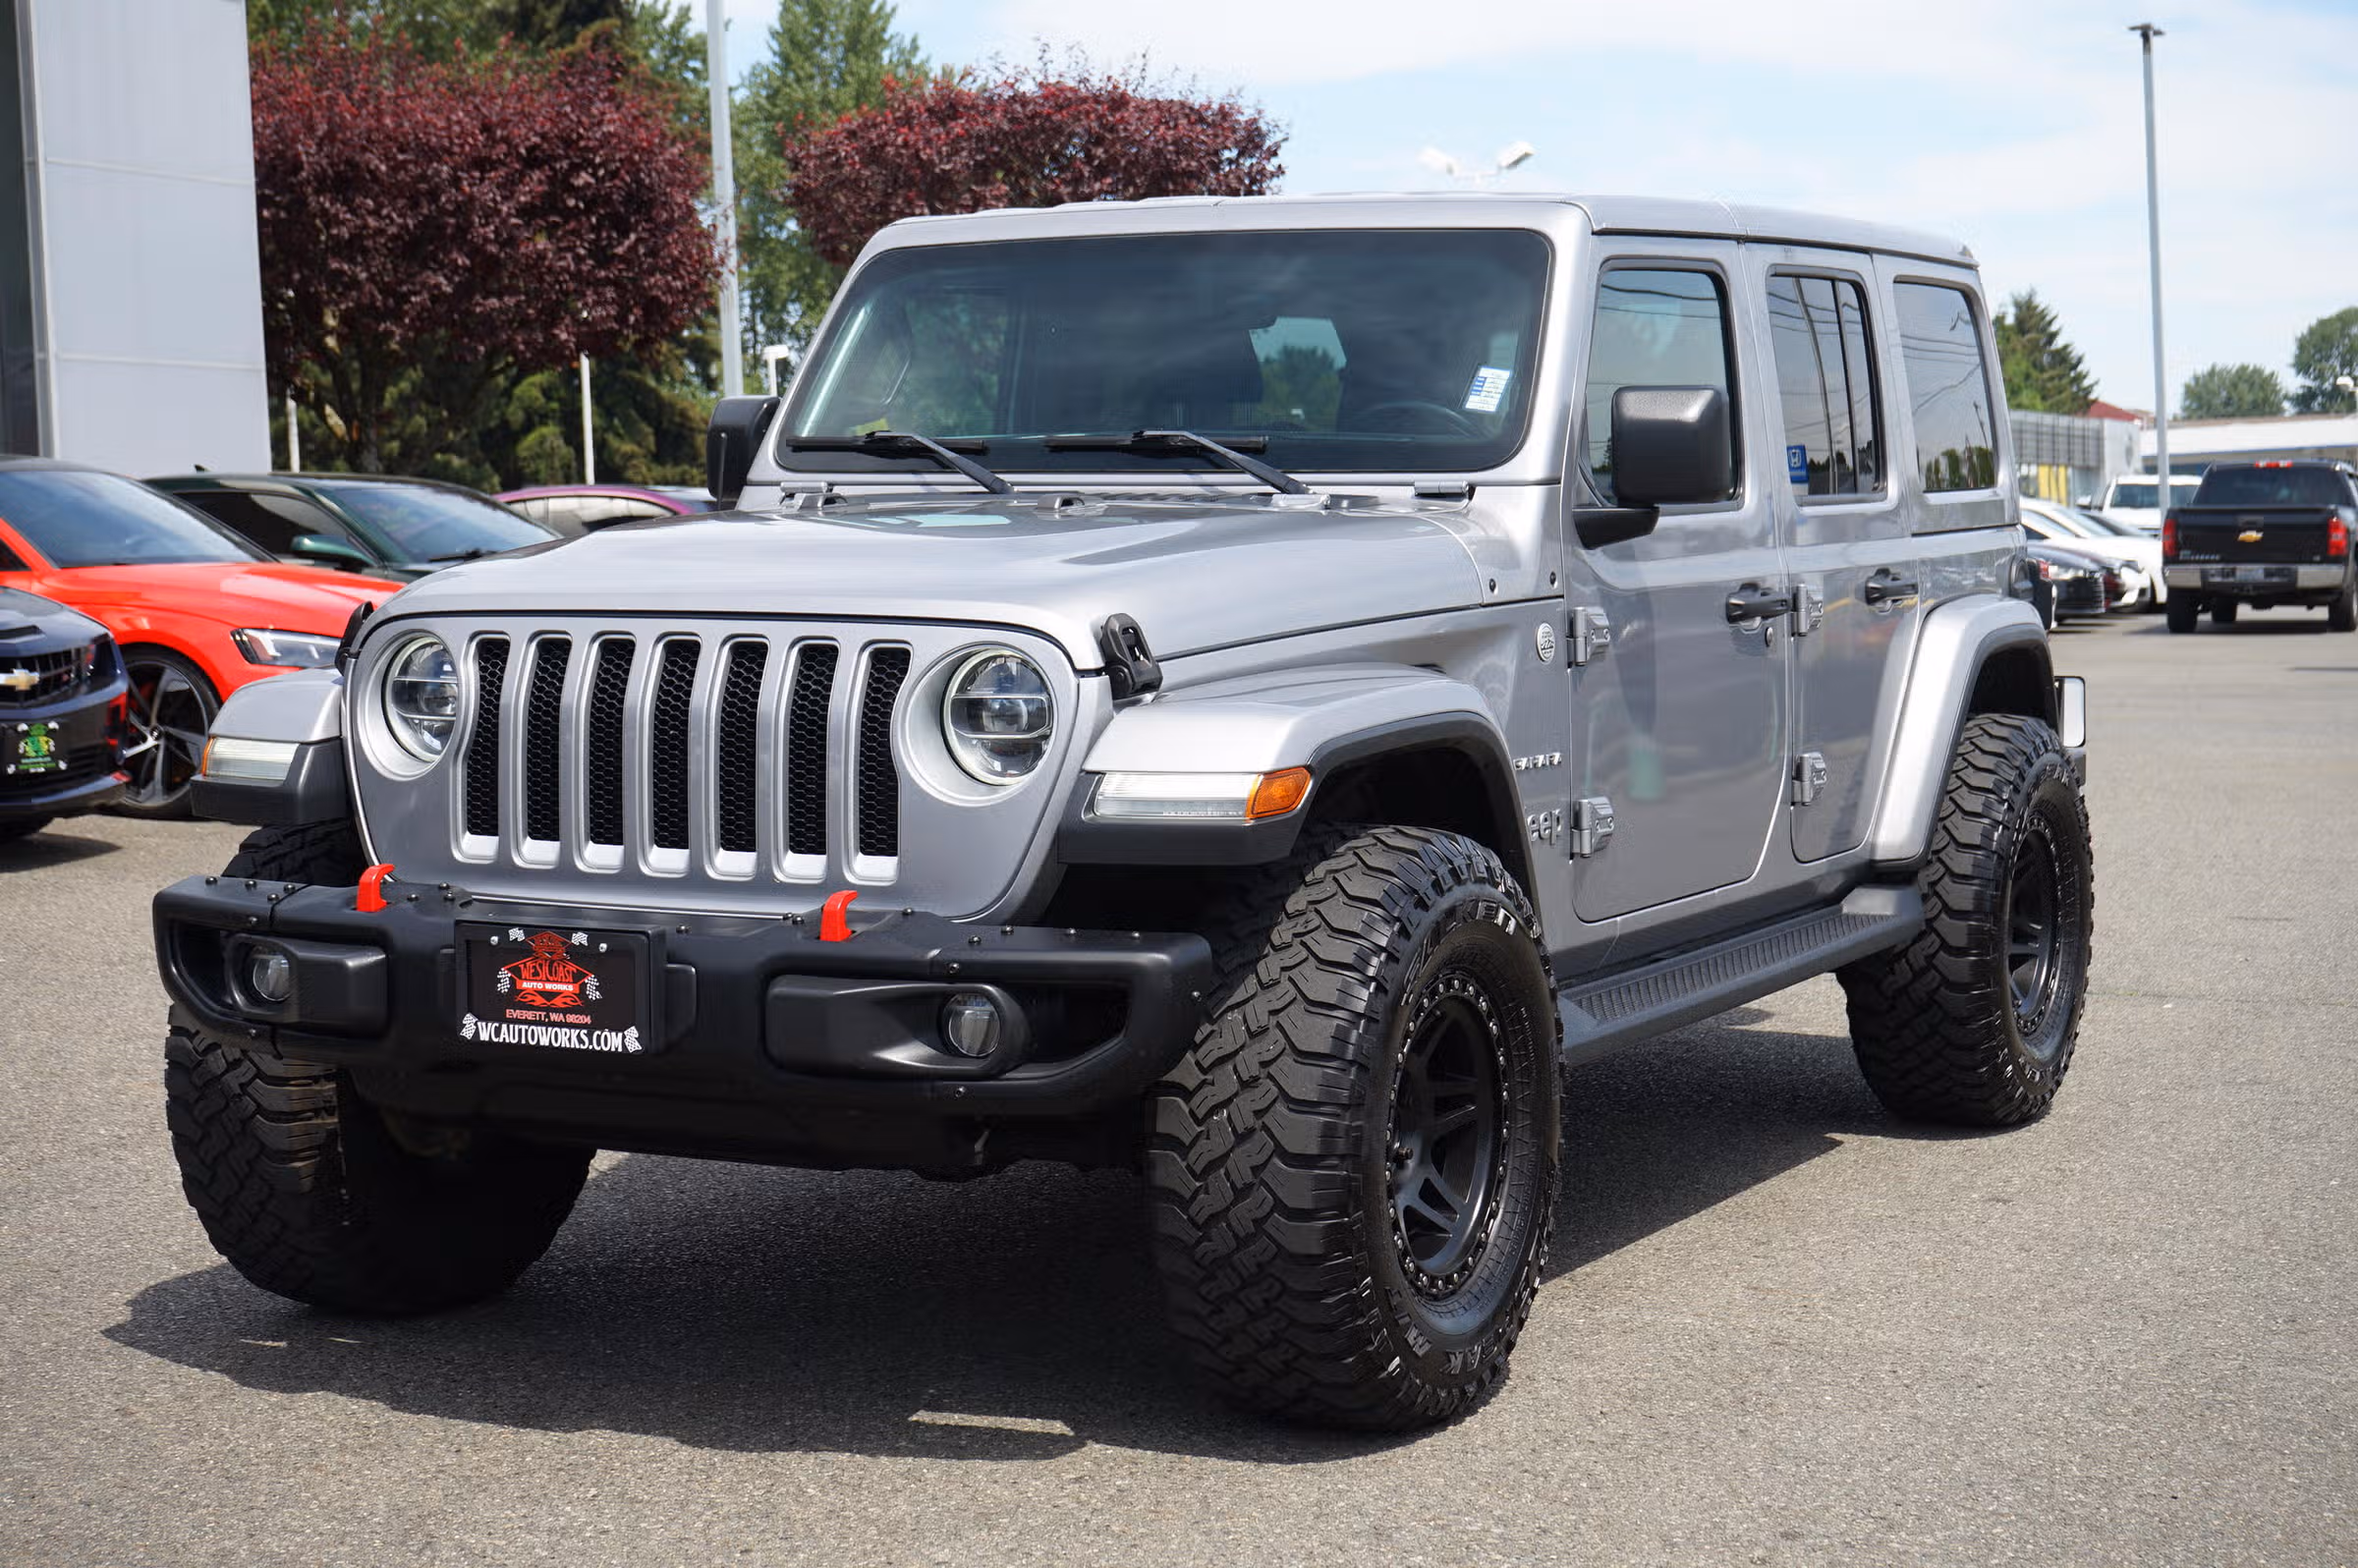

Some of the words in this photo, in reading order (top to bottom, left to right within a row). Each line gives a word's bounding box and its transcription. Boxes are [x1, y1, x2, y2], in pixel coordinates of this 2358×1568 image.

[1524, 808, 1562, 846] eep
[544, 982, 574, 991] WORKS
[506, 1009, 548, 1023] EVERETT,
[549, 1012, 565, 1023] WA
[477, 1021, 623, 1052] WCAUTOWORKS.COM
